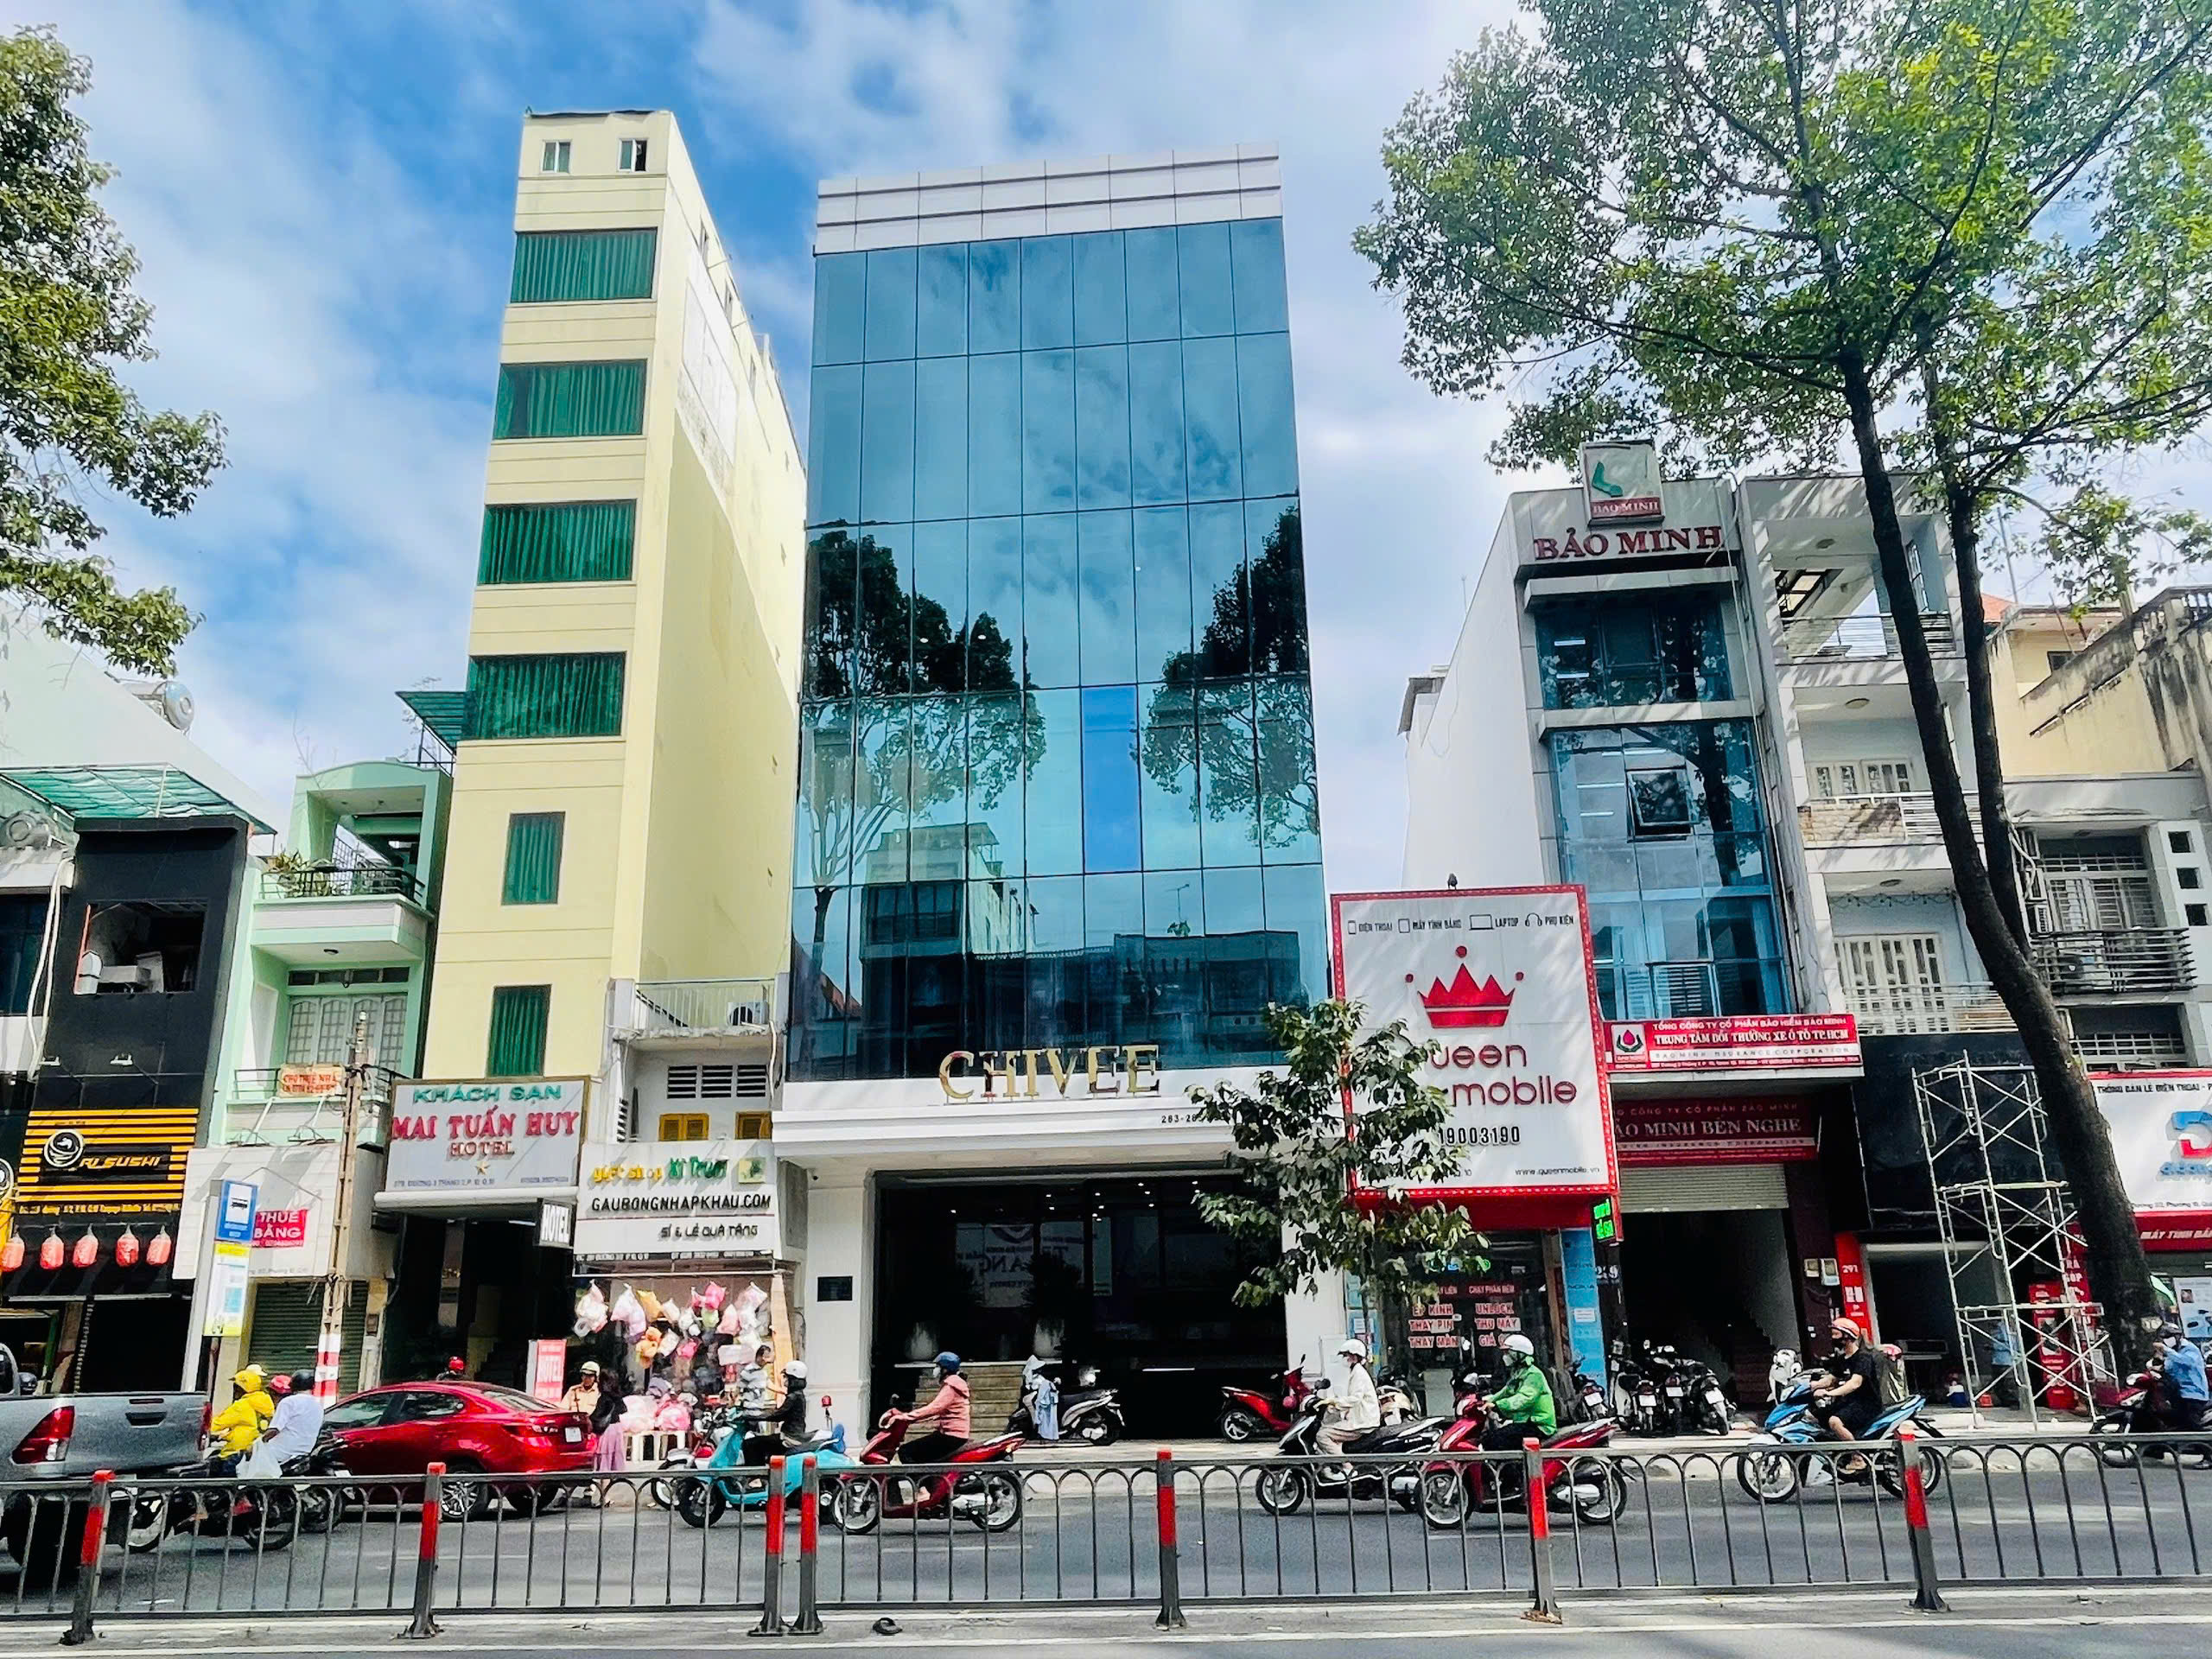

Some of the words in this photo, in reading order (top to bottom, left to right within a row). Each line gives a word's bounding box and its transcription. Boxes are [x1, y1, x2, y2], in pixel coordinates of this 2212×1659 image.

[1621, 501, 1659, 512] MINH
[1534, 527, 1609, 561] BẢO
[1617, 525, 1725, 555] MINH
[1679, 1020, 1705, 1030] CÔNG
[1655, 1034, 1688, 1045] TRUNG
[1772, 1031, 1787, 1041] XE
[1428, 1044, 1528, 1070] ueen
[938, 1044, 1160, 1099] CHIVEE
[413, 1086, 500, 1104] KHÁCH
[509, 1084, 563, 1105] SẠN
[1452, 1075, 1578, 1108] mobile
[391, 1115, 437, 1141] MAI
[448, 1104, 517, 1140] TUẤN
[525, 1111, 580, 1137] HUY
[1643, 1122, 1696, 1137] MINH
[1439, 1126, 1521, 1146] 19003190
[448, 1141, 516, 1158] HOTEL
[591, 1193, 772, 1212] GAUBONGNHAPKHAU.COM
[540, 1204, 570, 1243] HOTEL
[1408, 1319, 1433, 1332] THAY
[1474, 1317, 1496, 1331] THU
[1408, 1336, 1434, 1349] THAY
